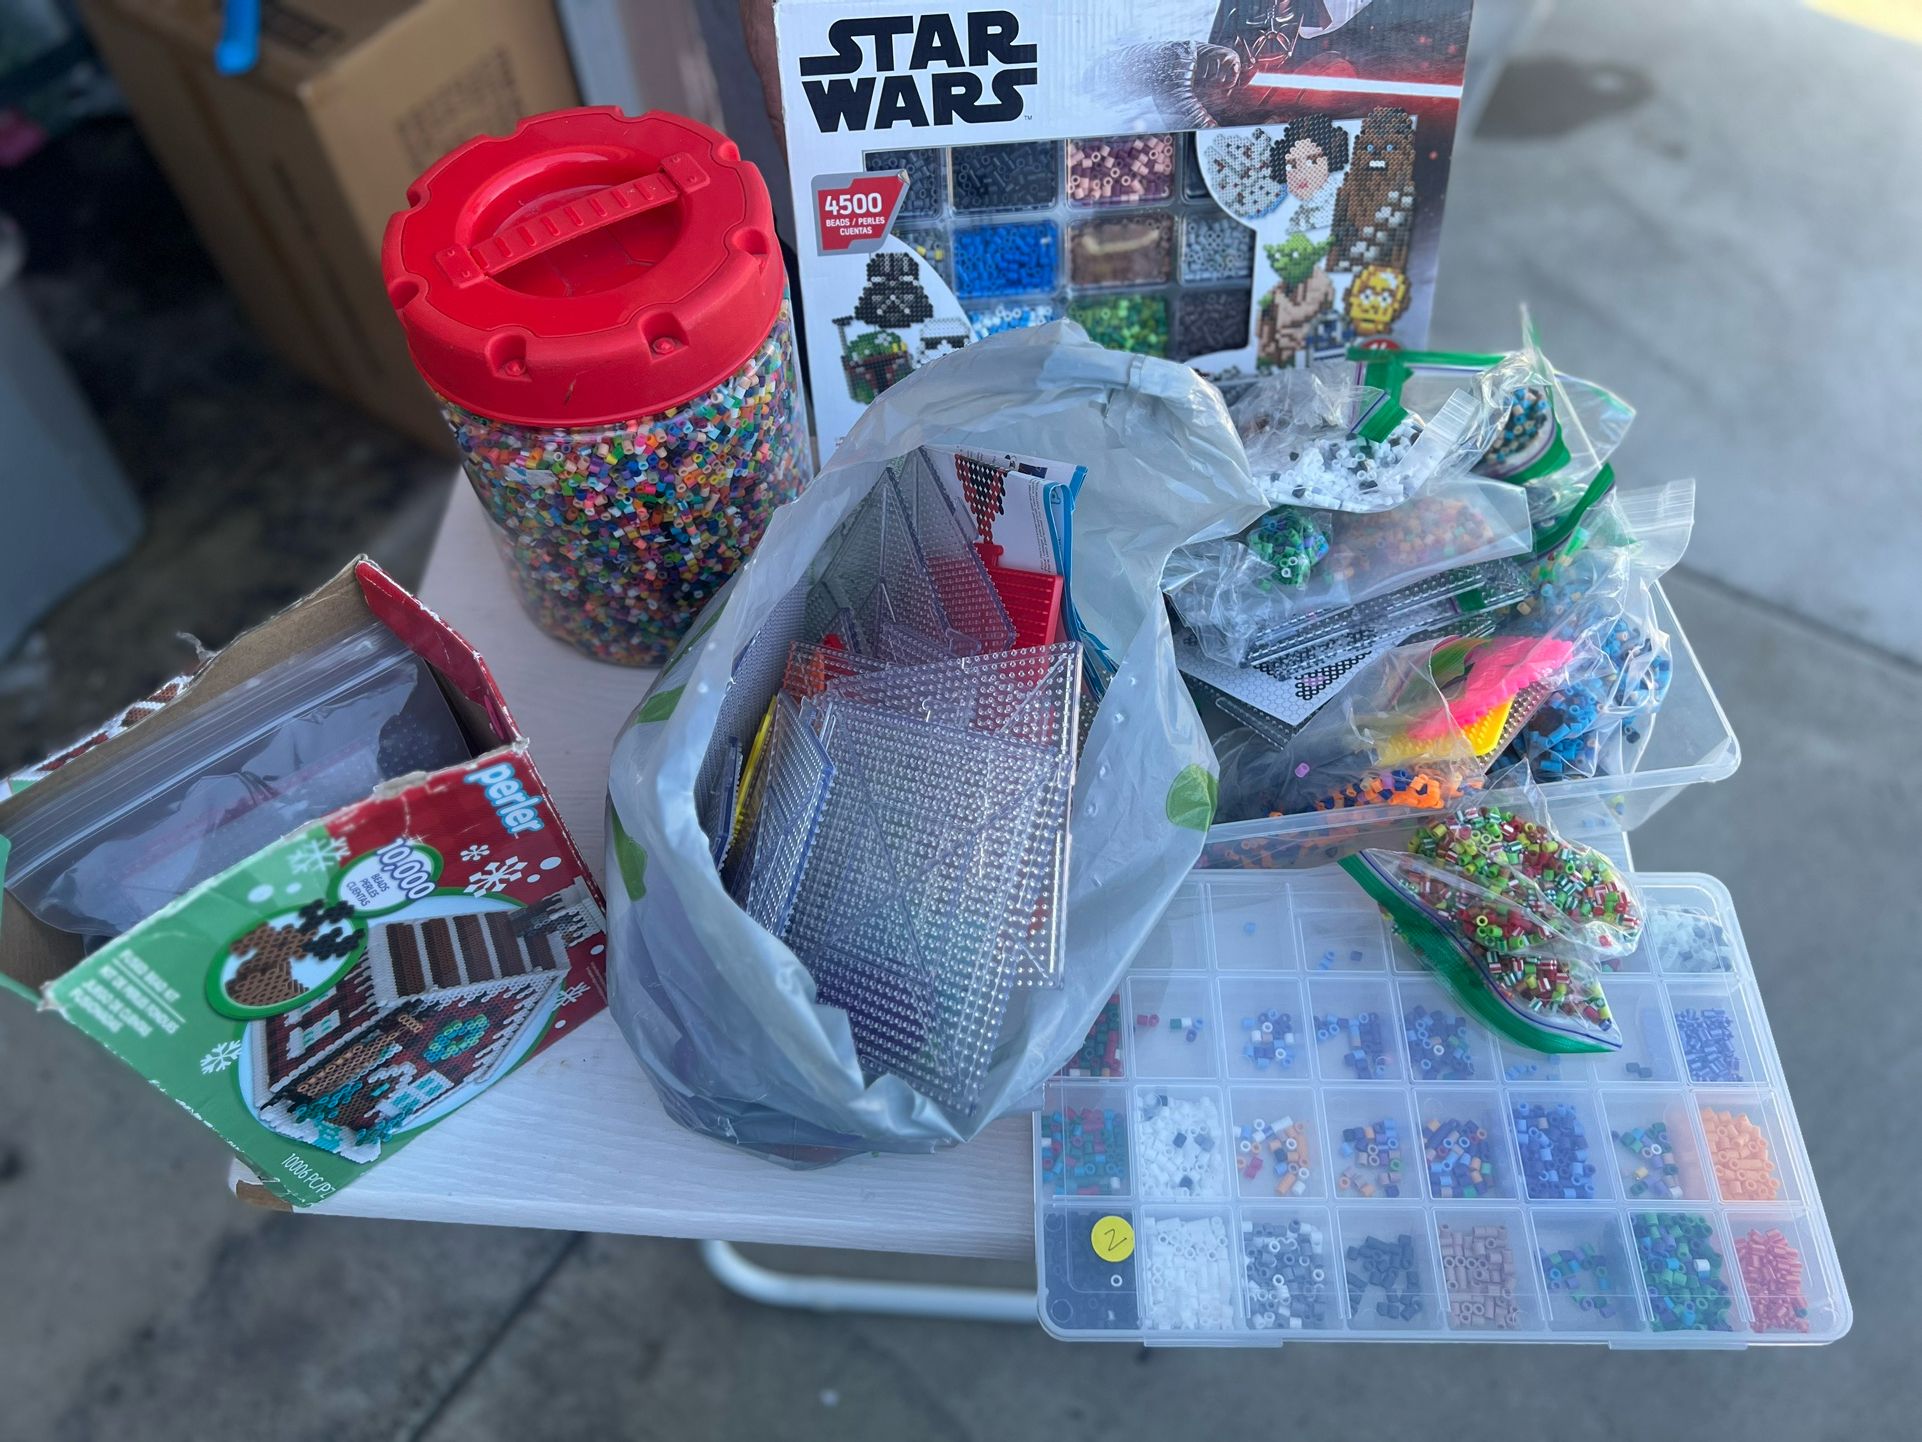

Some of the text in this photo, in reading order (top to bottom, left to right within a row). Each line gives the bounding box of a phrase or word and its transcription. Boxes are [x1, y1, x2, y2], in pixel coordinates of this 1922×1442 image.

[799, 10, 1038, 76] STAR
[801, 67, 1038, 133] WARS
[825, 192, 882, 215] 4500
[826, 218, 850, 227] BEADS
[858, 217, 885, 225] PERLES
[839, 226, 872, 235] CUENTAS
[464, 763, 544, 833] perler
[376, 837, 436, 901] 10,000
[346, 881, 371, 907] CUENTAS
[360, 878, 380, 898] PERLES
[371, 873, 390, 893] BEADS
[282, 1153, 336, 1199] 10006 PC/PZ
